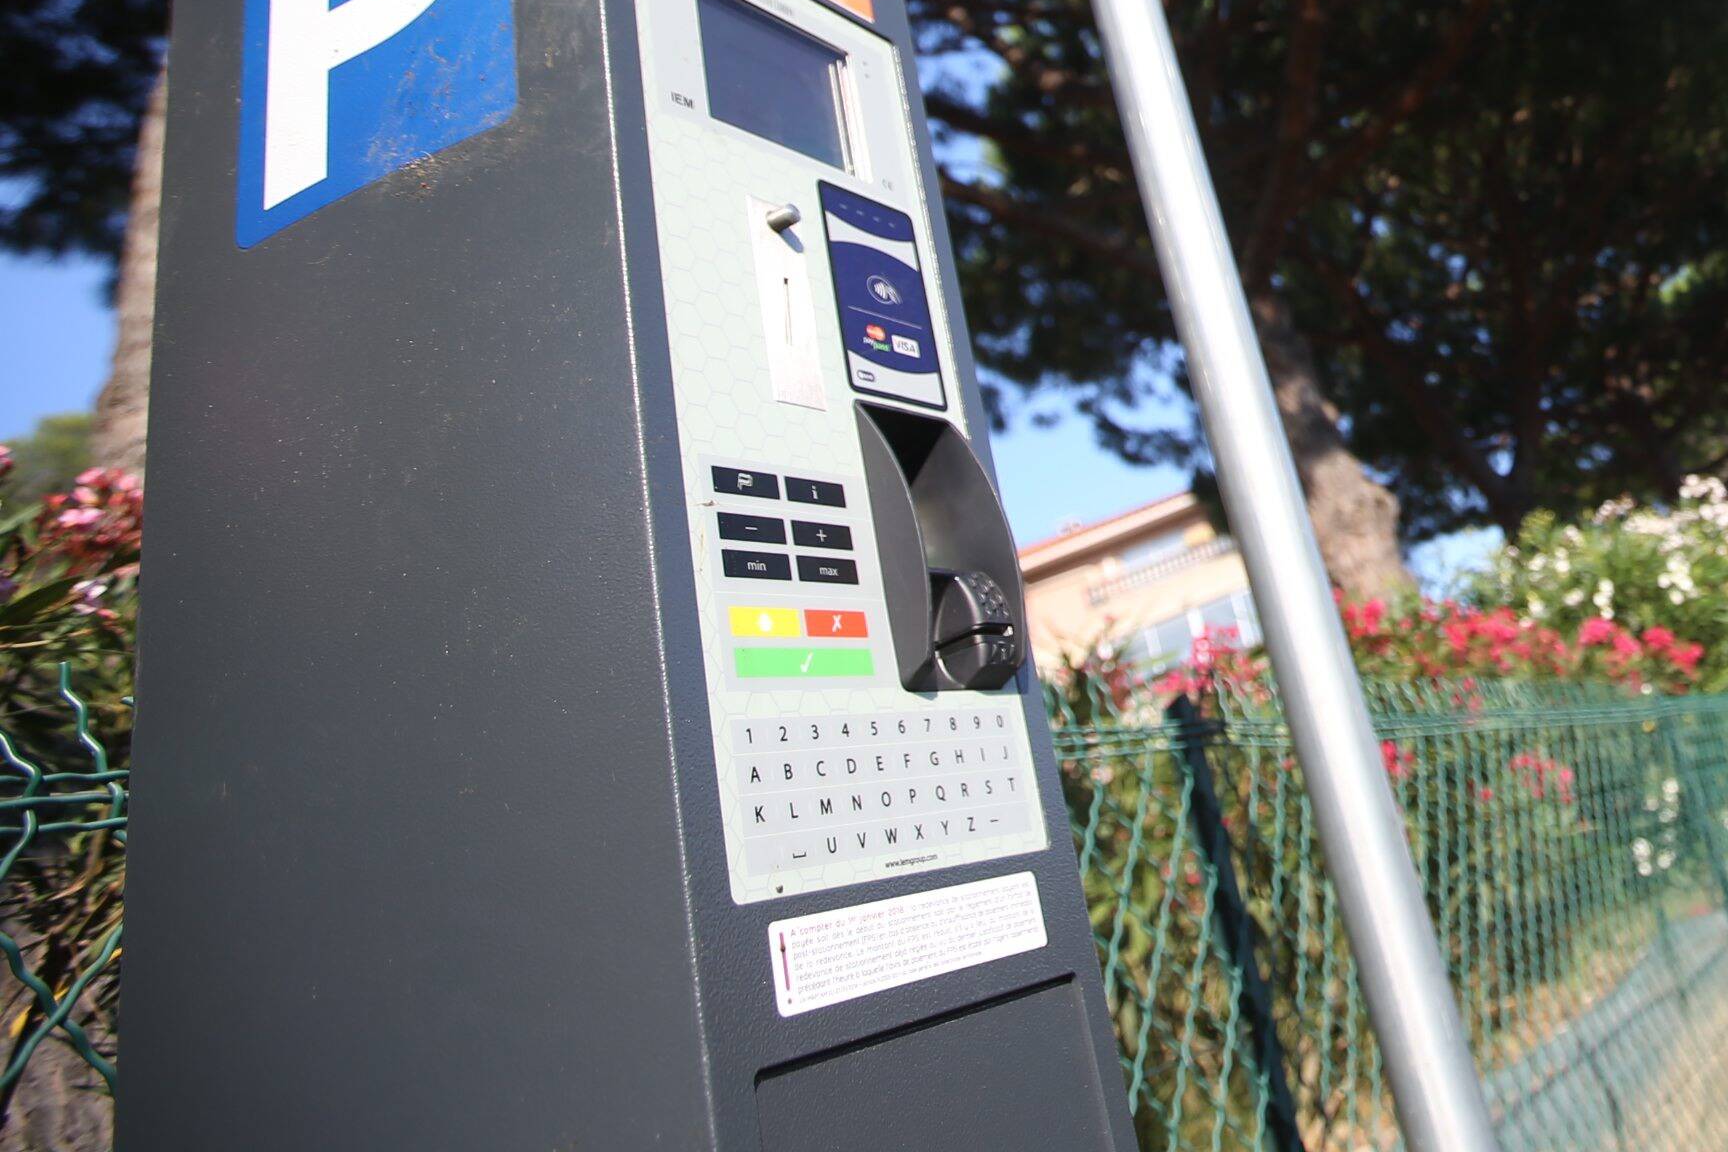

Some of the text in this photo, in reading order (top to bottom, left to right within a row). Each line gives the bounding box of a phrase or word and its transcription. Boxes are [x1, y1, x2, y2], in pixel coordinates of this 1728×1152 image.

[671, 91, 694, 109] IEM
[896, 341, 916, 354] VISA
[747, 560, 839, 577] min max
[745, 715, 1004, 744] 1 2 3 4 5 6 7 8 9 0
[750, 747, 1008, 784] A B C D E F G H I J
[754, 778, 1015, 824] K L M N O P Q R S T
[826, 837, 838, 855] U
[856, 832, 867, 849] V
[884, 828, 898, 845] W
[913, 824, 925, 841] X
[940, 820, 949, 836] Y
[966, 817, 976, 833] Z
